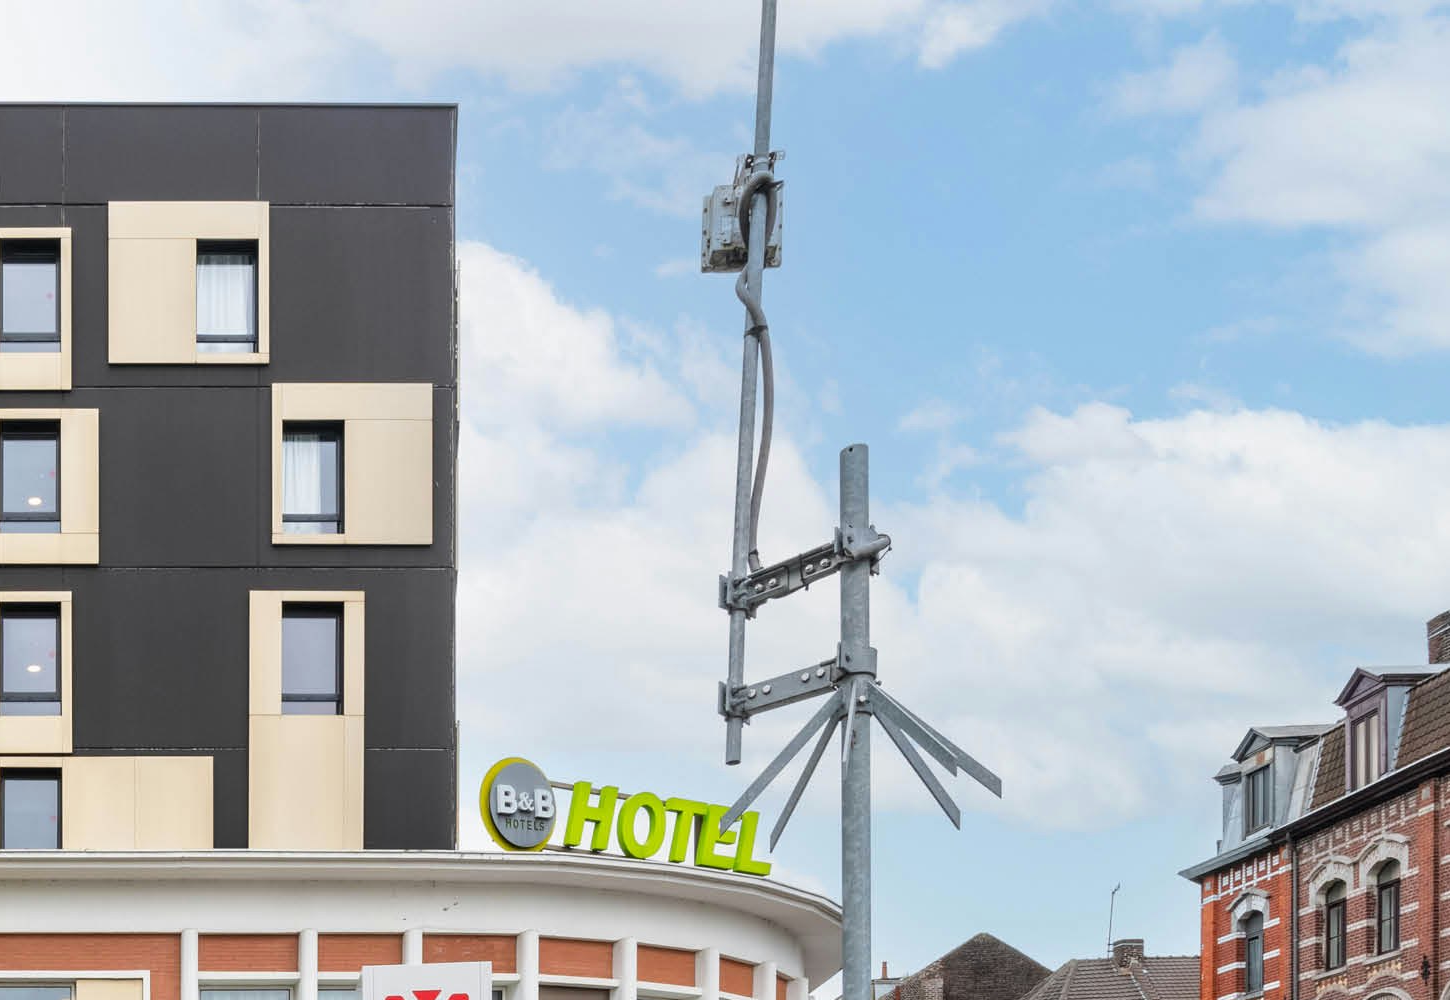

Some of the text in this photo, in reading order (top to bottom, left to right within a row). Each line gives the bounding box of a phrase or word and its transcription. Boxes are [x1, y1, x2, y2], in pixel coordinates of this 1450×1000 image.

[497, 784, 555, 819] B&B
[505, 818, 545, 831] HOTELS
[564, 780, 772, 877] HOTEL
